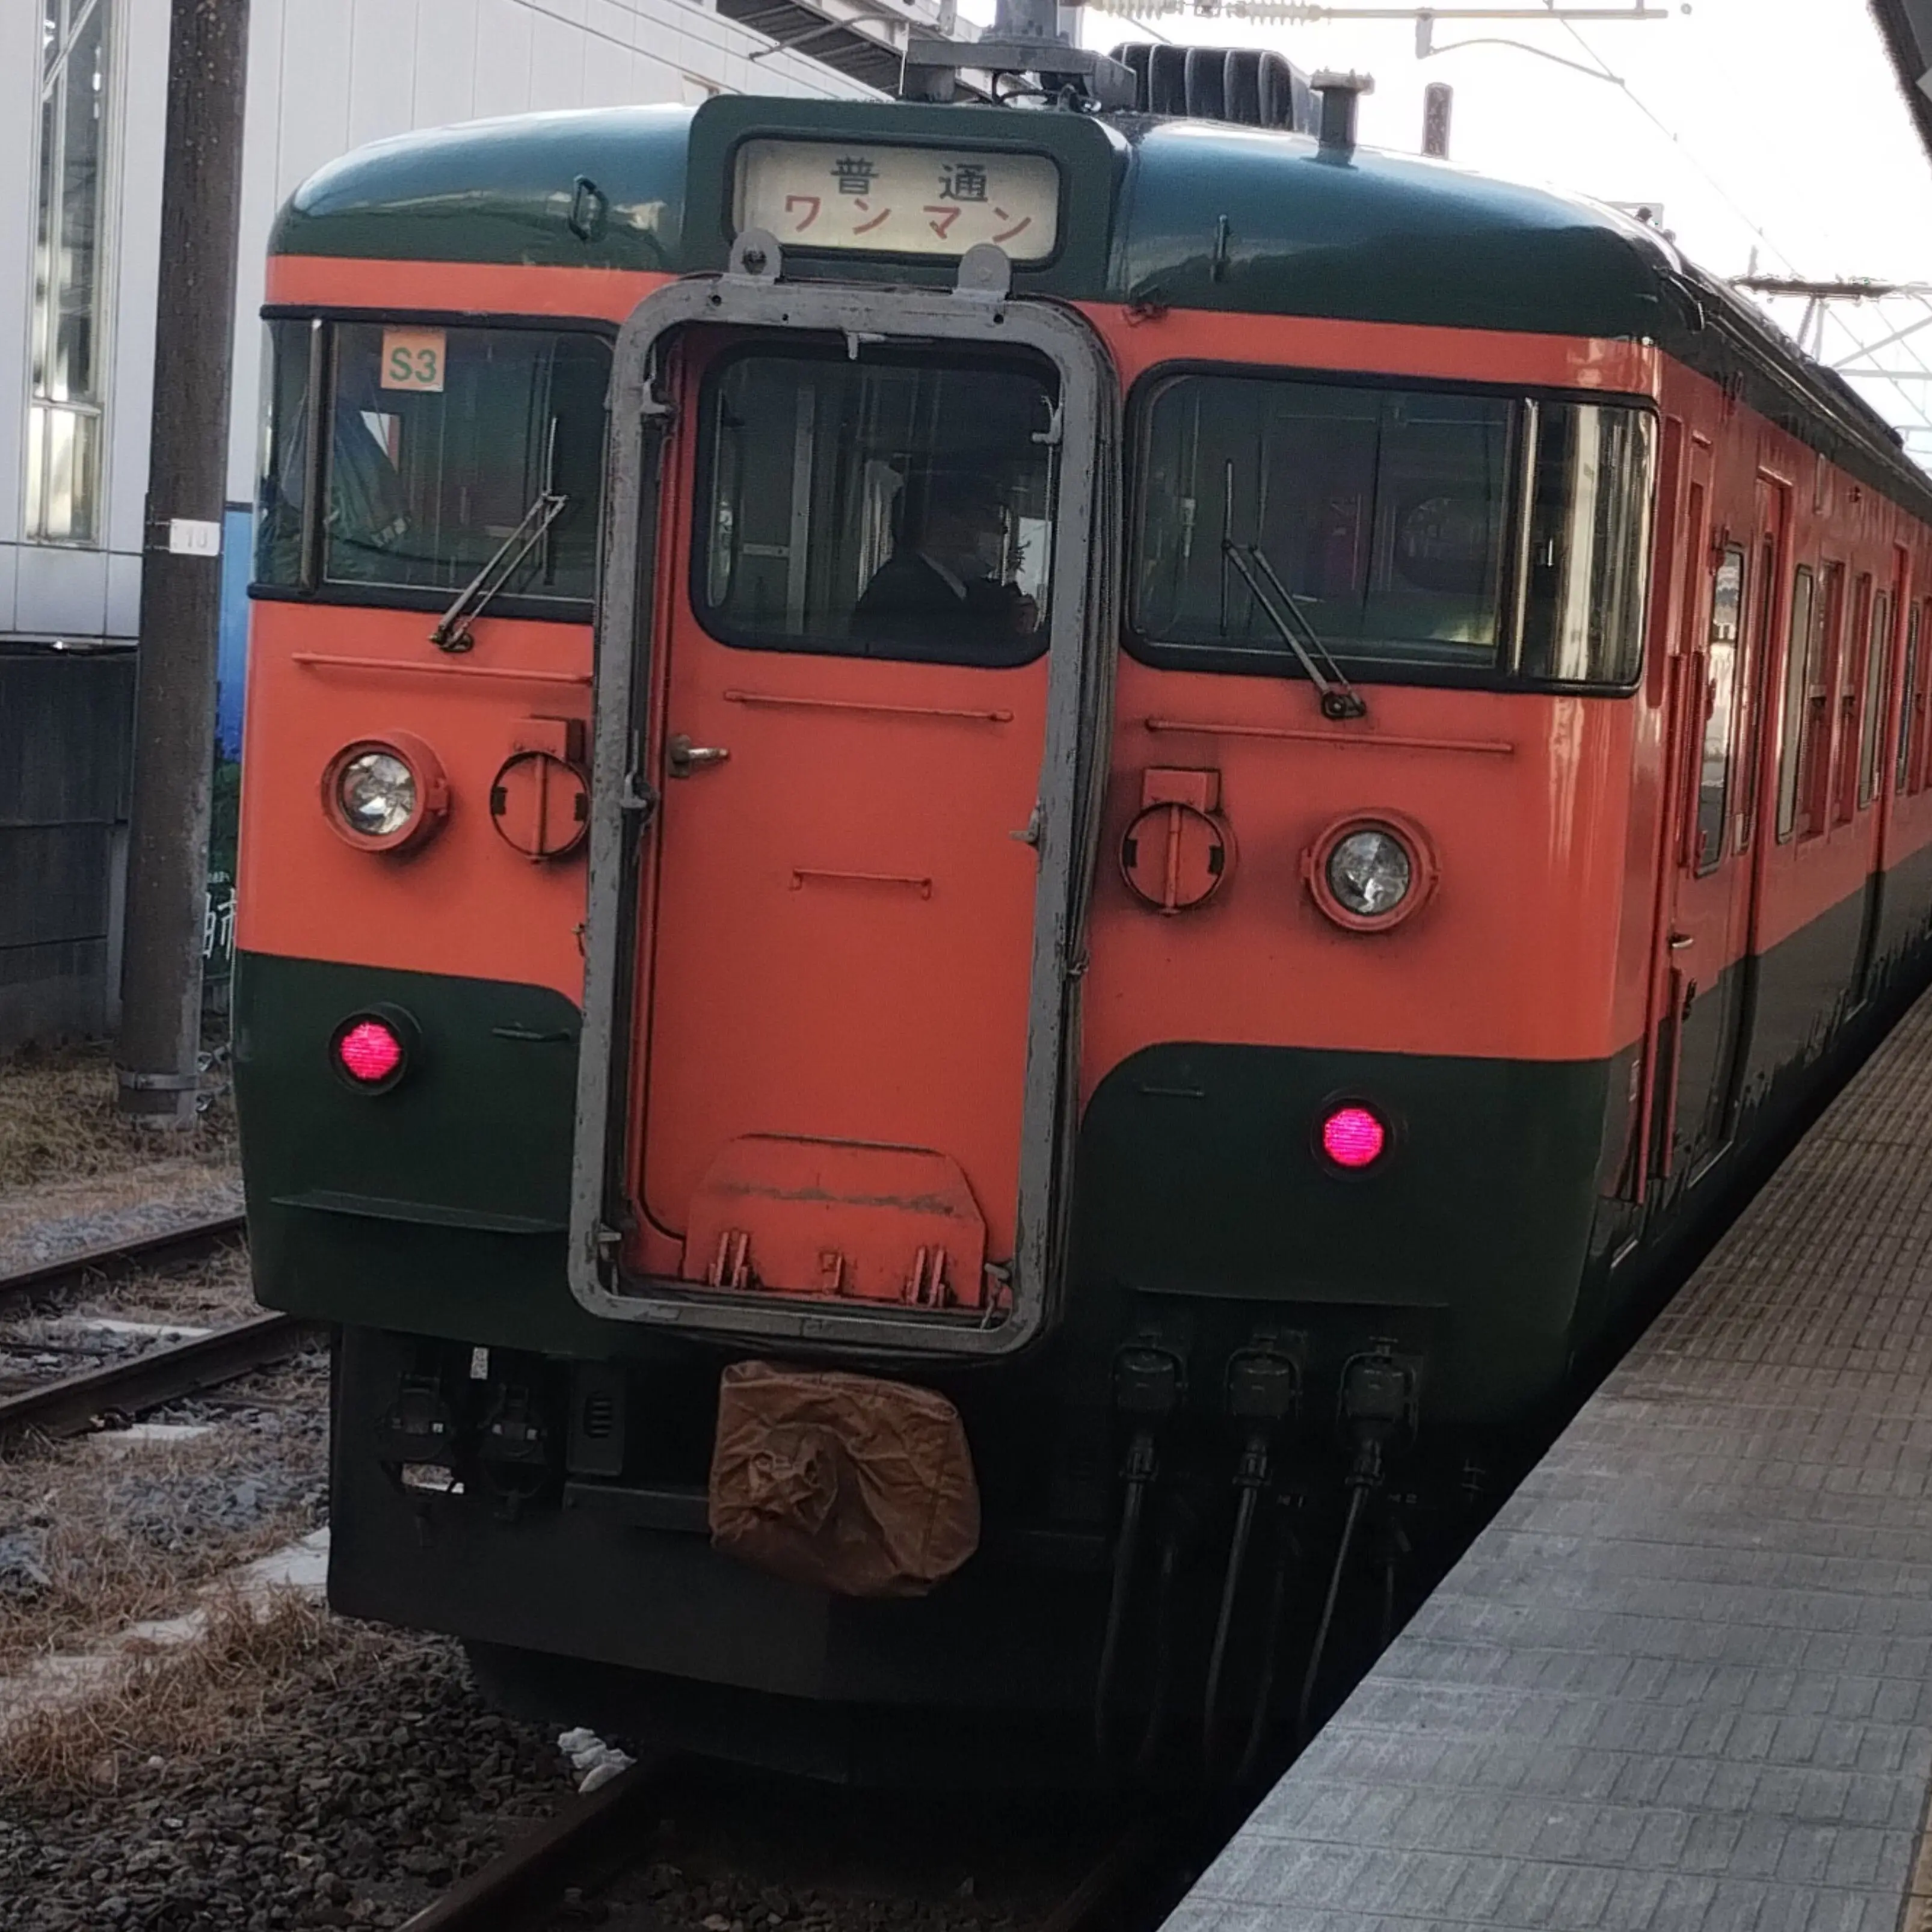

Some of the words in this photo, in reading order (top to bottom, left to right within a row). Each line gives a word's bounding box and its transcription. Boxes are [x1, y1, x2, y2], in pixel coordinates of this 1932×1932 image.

[830, 156, 988, 203] 普通
[786, 195, 1031, 243] ワンマン
[389, 347, 437, 383] S3
